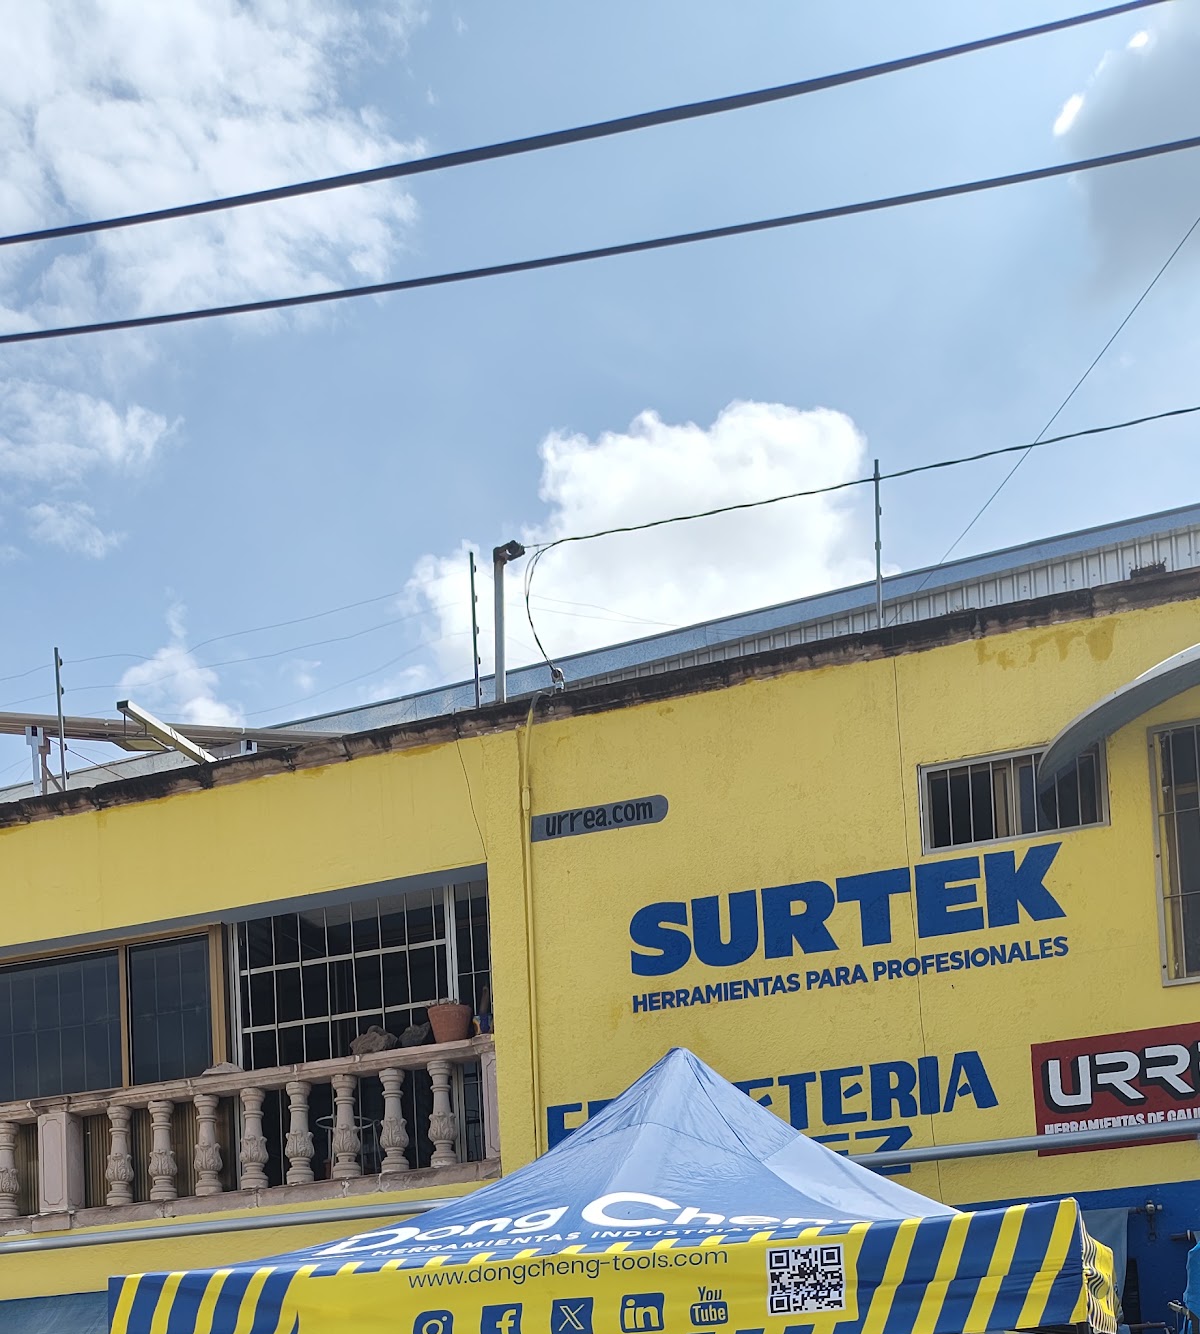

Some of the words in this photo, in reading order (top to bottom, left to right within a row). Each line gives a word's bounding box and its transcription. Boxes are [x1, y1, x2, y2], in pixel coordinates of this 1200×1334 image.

[545, 799, 653, 837] urrea.com
[630, 842, 1066, 977] SURTEK
[632, 973, 801, 1013] HERRAMIENTAS
[805, 964, 865, 991] PARA
[872, 936, 1069, 981] PROFESIONALES
[1047, 1041, 1200, 1108] URR
[1167, 1107, 1200, 1121] CALI
[300, 1206, 569, 1260] Dong
[372, 1231, 580, 1256] HERRAMIENTAS
[408, 1250, 728, 1288] www.dongcheng-tools.com
[697, 1286, 722, 1301] You
[693, 1302, 727, 1324] Tube
